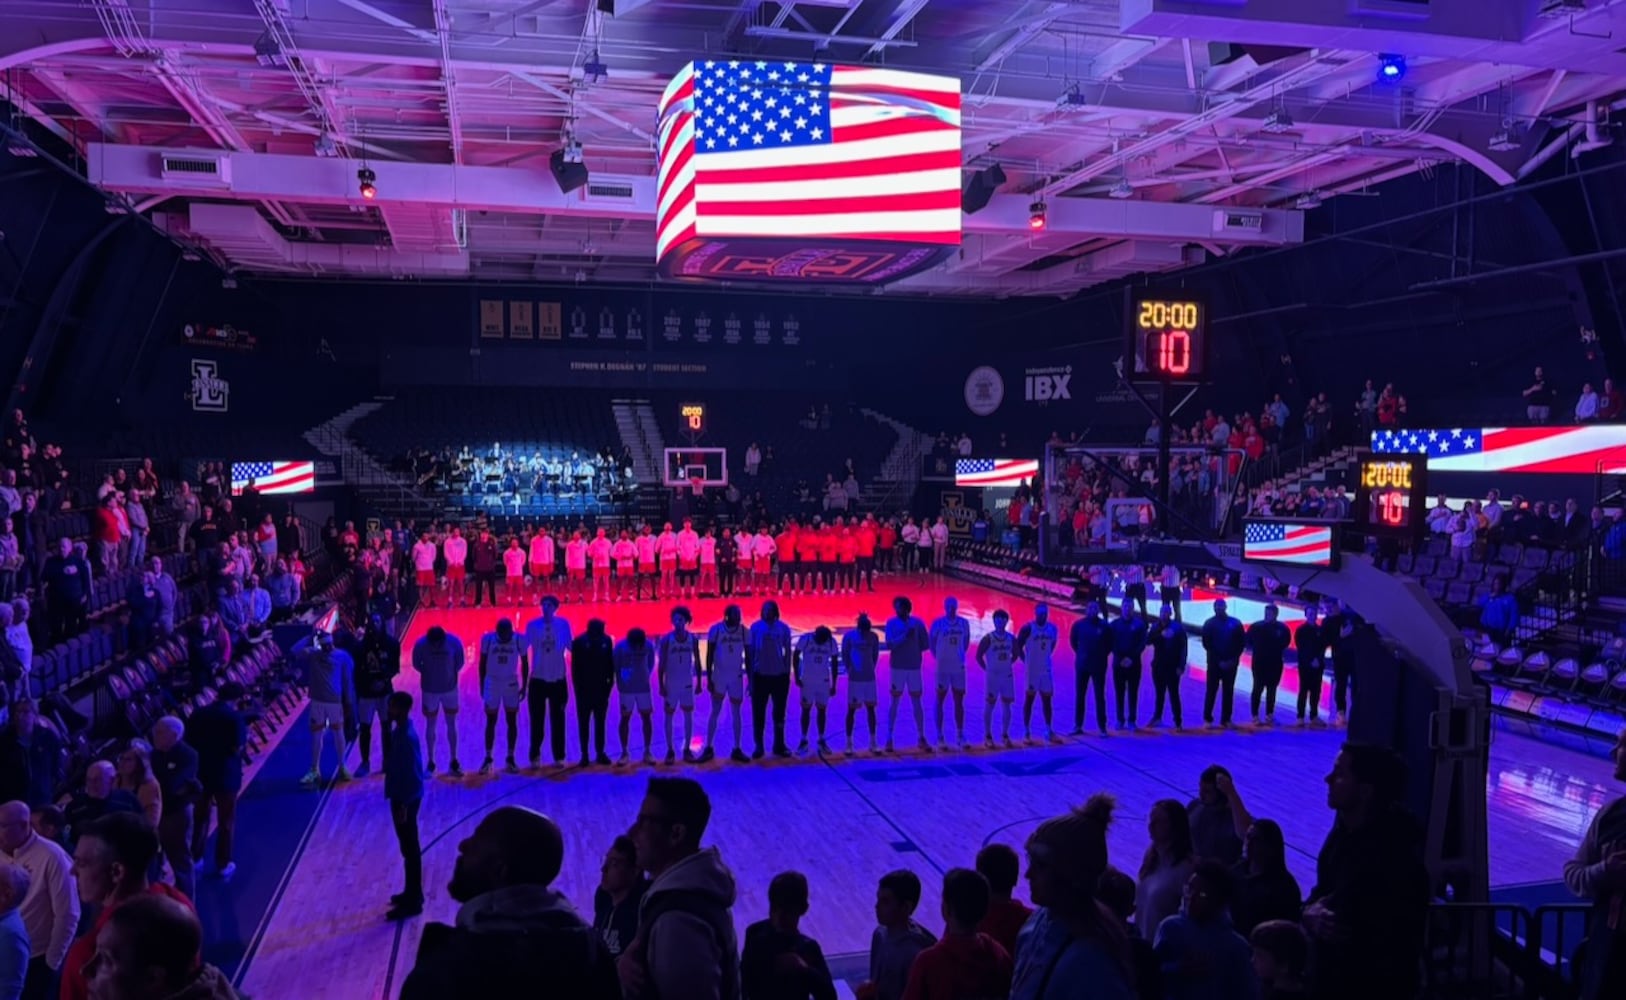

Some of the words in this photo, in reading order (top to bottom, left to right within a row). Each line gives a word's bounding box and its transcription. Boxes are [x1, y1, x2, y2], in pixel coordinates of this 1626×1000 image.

[1139, 301, 1198, 329] 20:00
[1160, 331, 1190, 374] 10
[1025, 374, 1072, 401] IBX
[1383, 492, 1403, 523] 10
